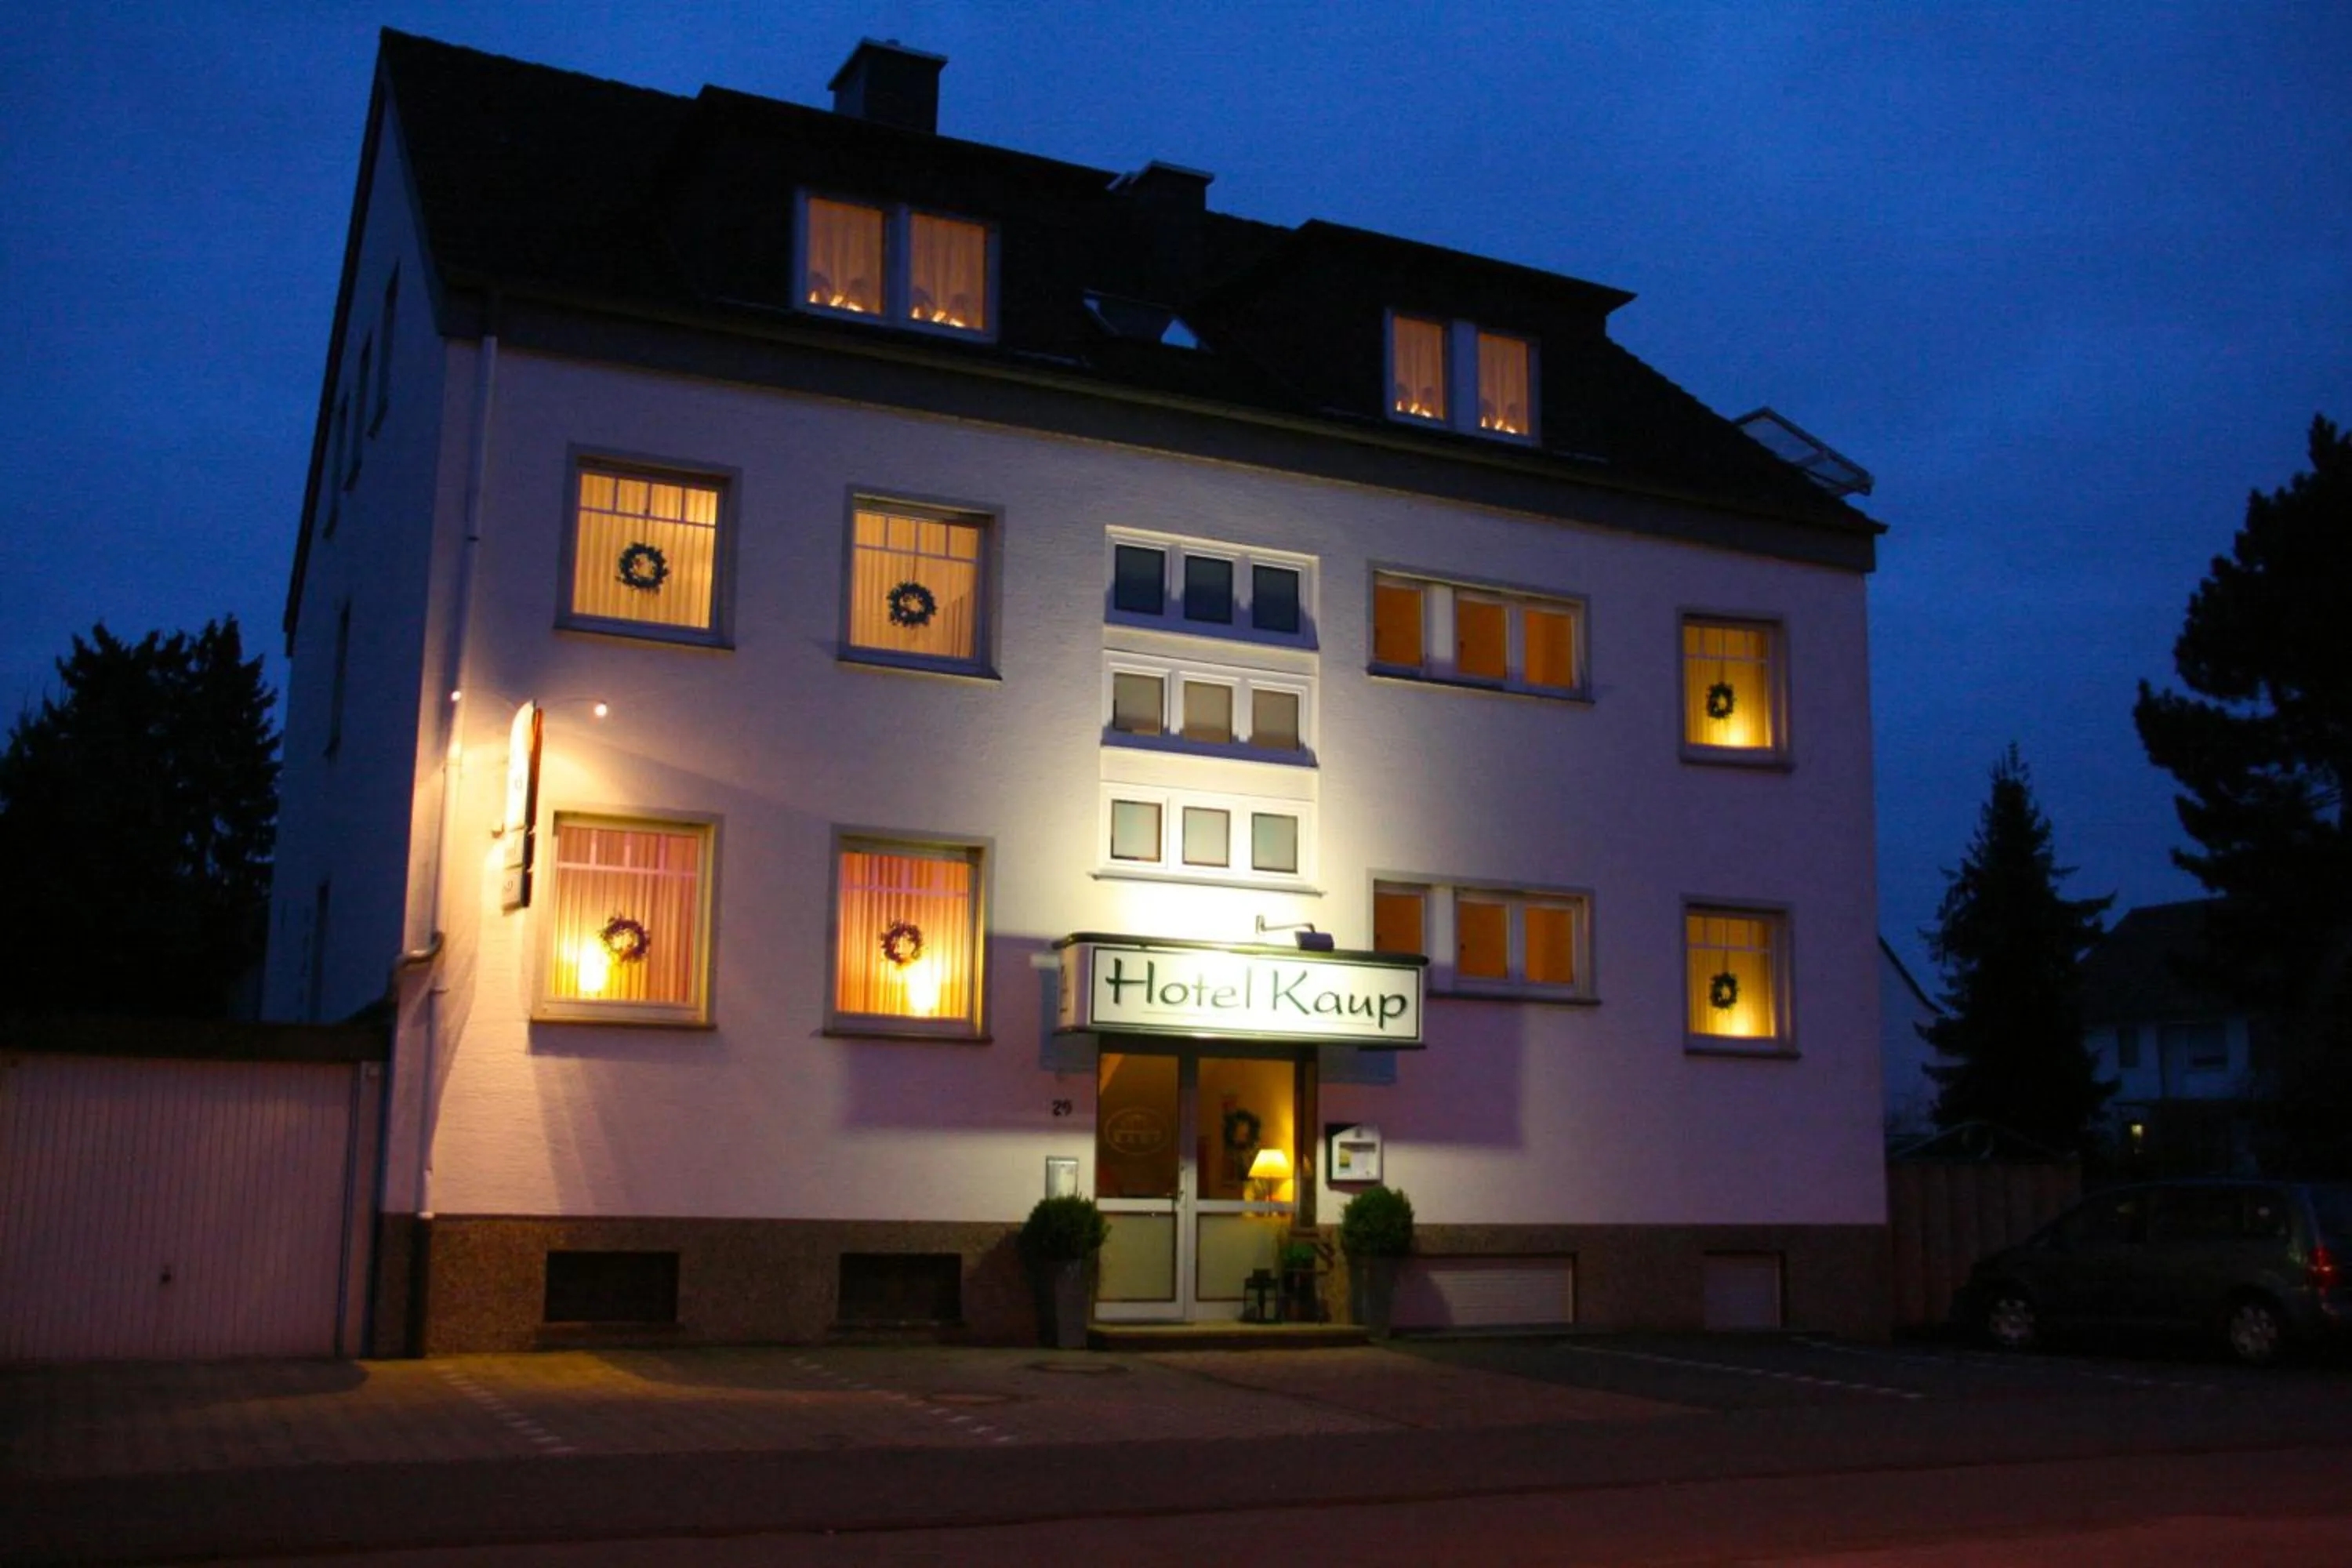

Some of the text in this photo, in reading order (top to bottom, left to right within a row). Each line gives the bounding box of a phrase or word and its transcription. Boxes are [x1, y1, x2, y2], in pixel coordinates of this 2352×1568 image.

[1105, 958, 1251, 1009] Hotel
[1272, 970, 1408, 1029] Kaup
[1052, 1099, 1073, 1116] 29
